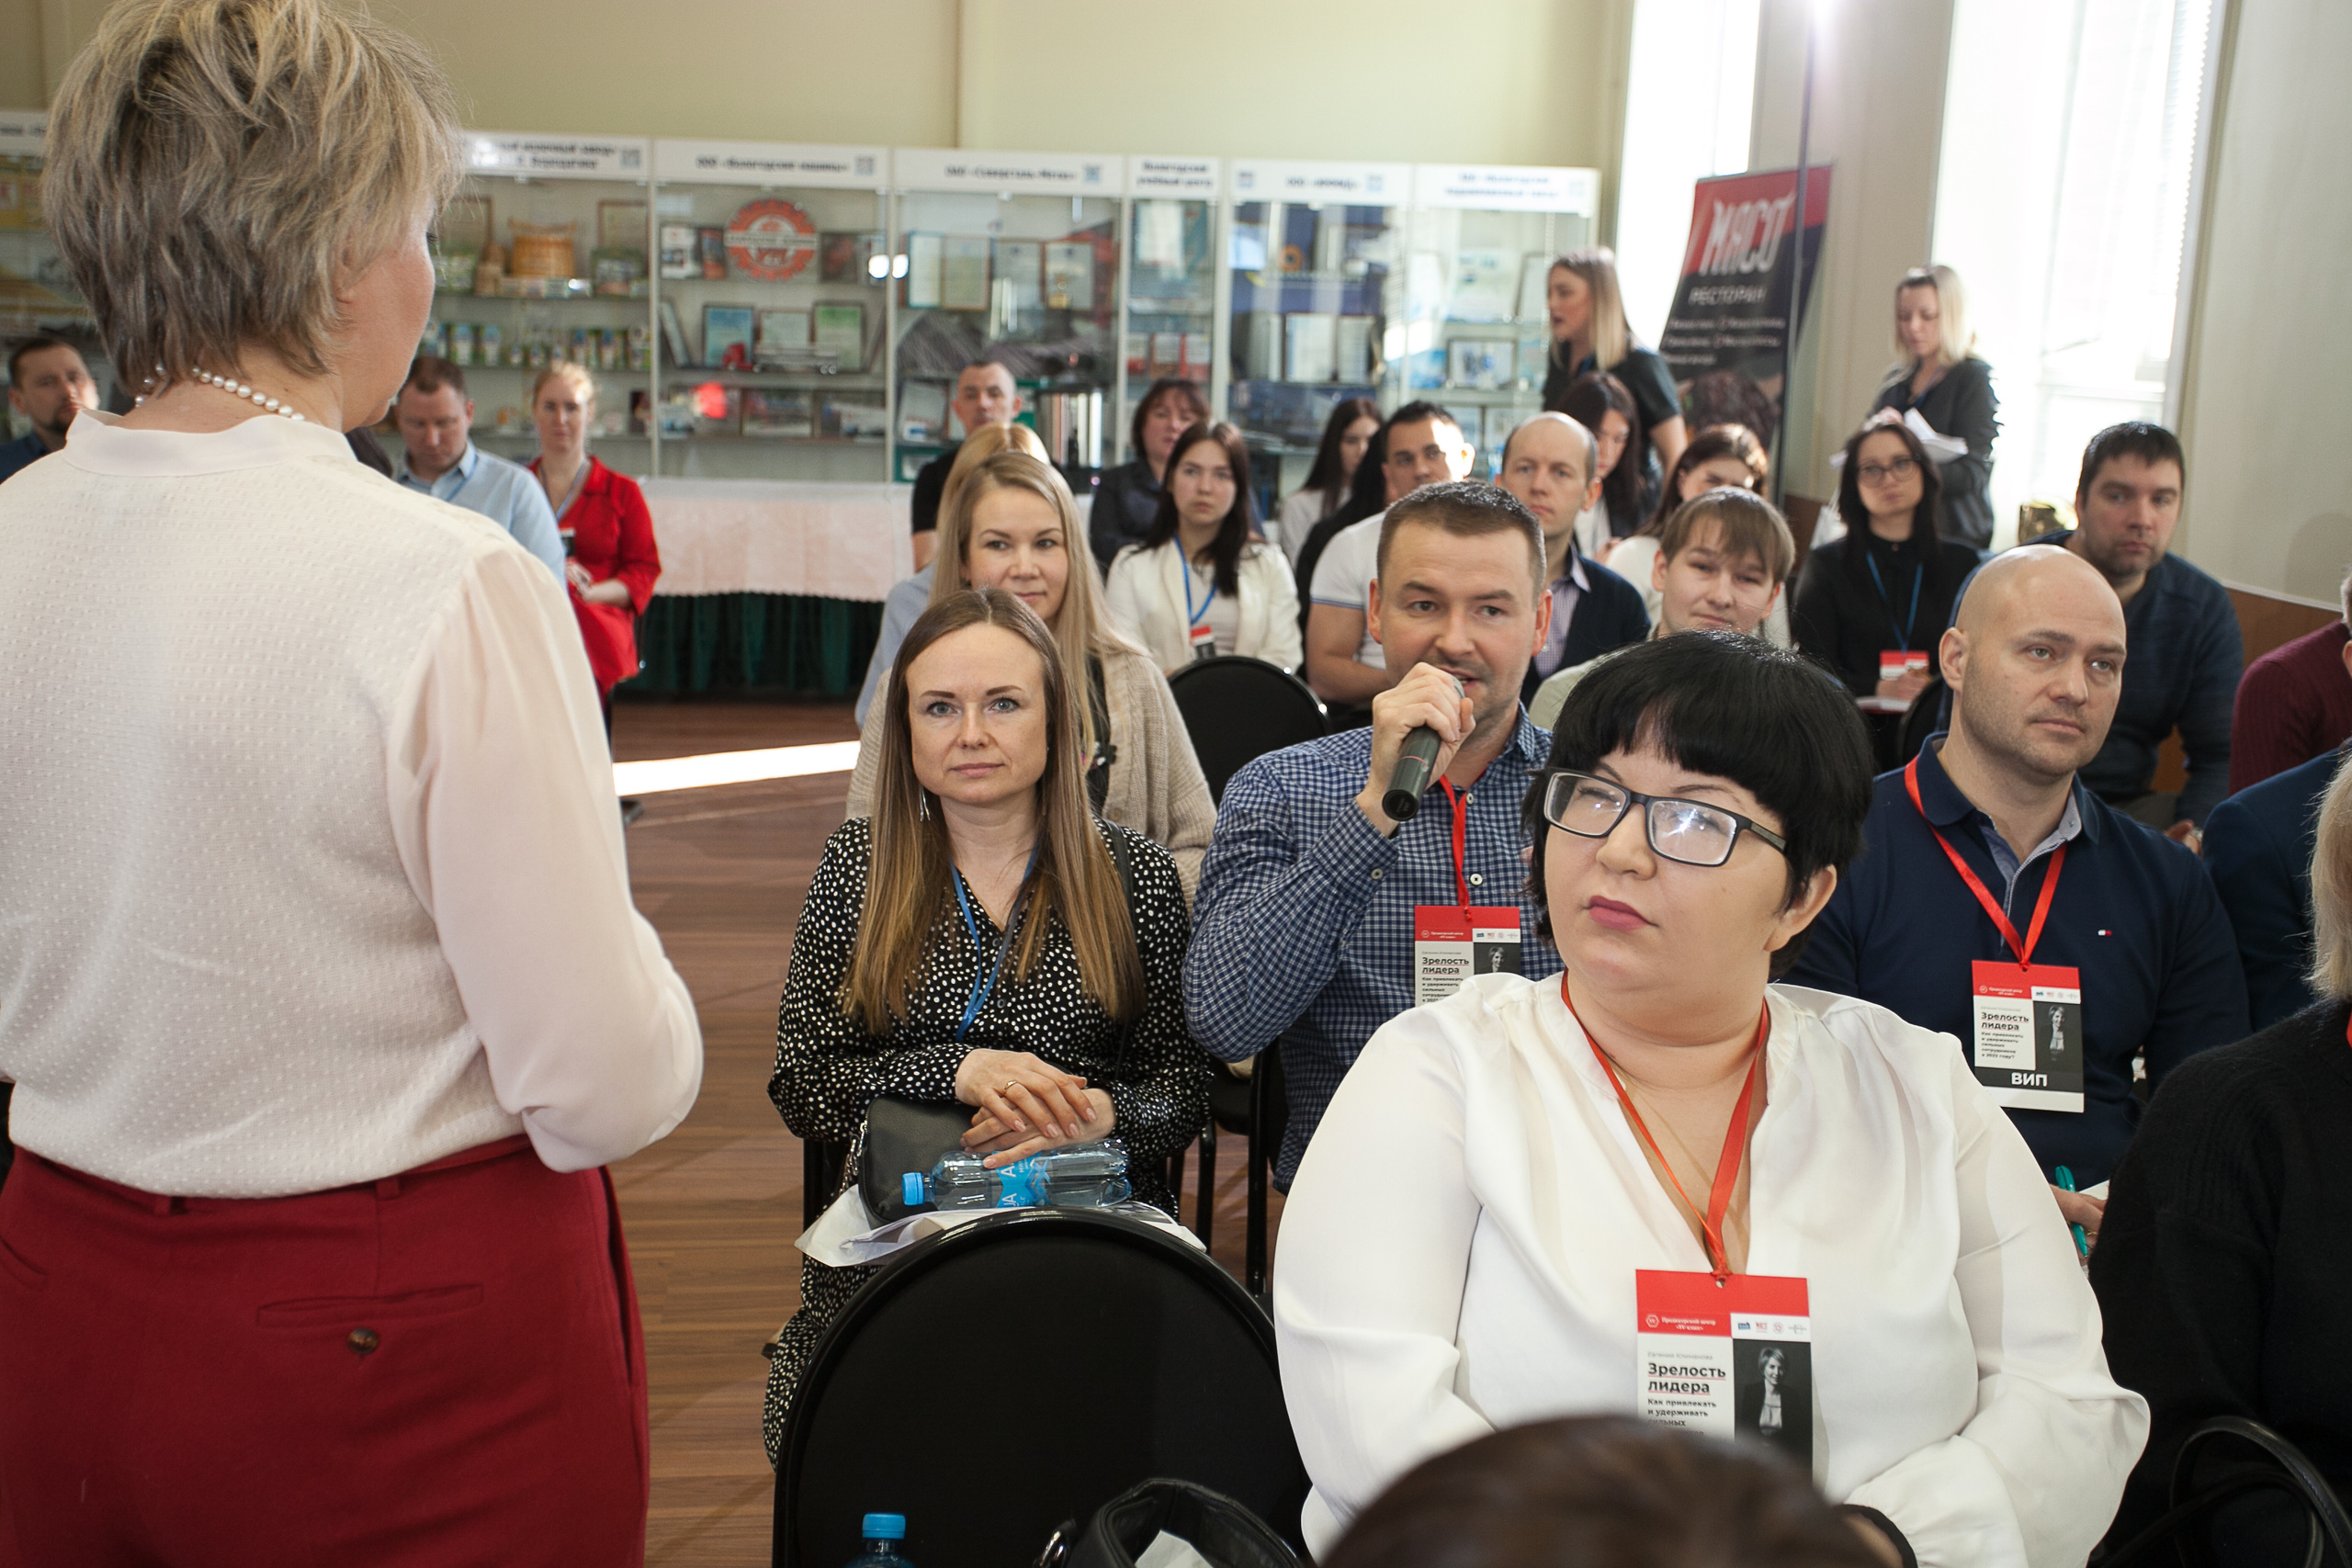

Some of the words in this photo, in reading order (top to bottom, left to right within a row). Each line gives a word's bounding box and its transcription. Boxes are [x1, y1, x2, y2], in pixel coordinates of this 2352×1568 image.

[1688, 284, 1769, 306] РЕСТОРАН
[1422, 956, 1470, 965] Зрелость
[1981, 1011, 2030, 1022] Зрелость
[1981, 1021, 2019, 1031] лидера
[2011, 1072, 2048, 1088] ВИП
[1647, 1362, 1726, 1378] Зрелость
[1647, 1381, 1711, 1394] лидера
[1647, 1398, 1664, 1406] Как
[1665, 1400, 1717, 1408] привлекать
[1655, 1409, 1709, 1417] удерживать
